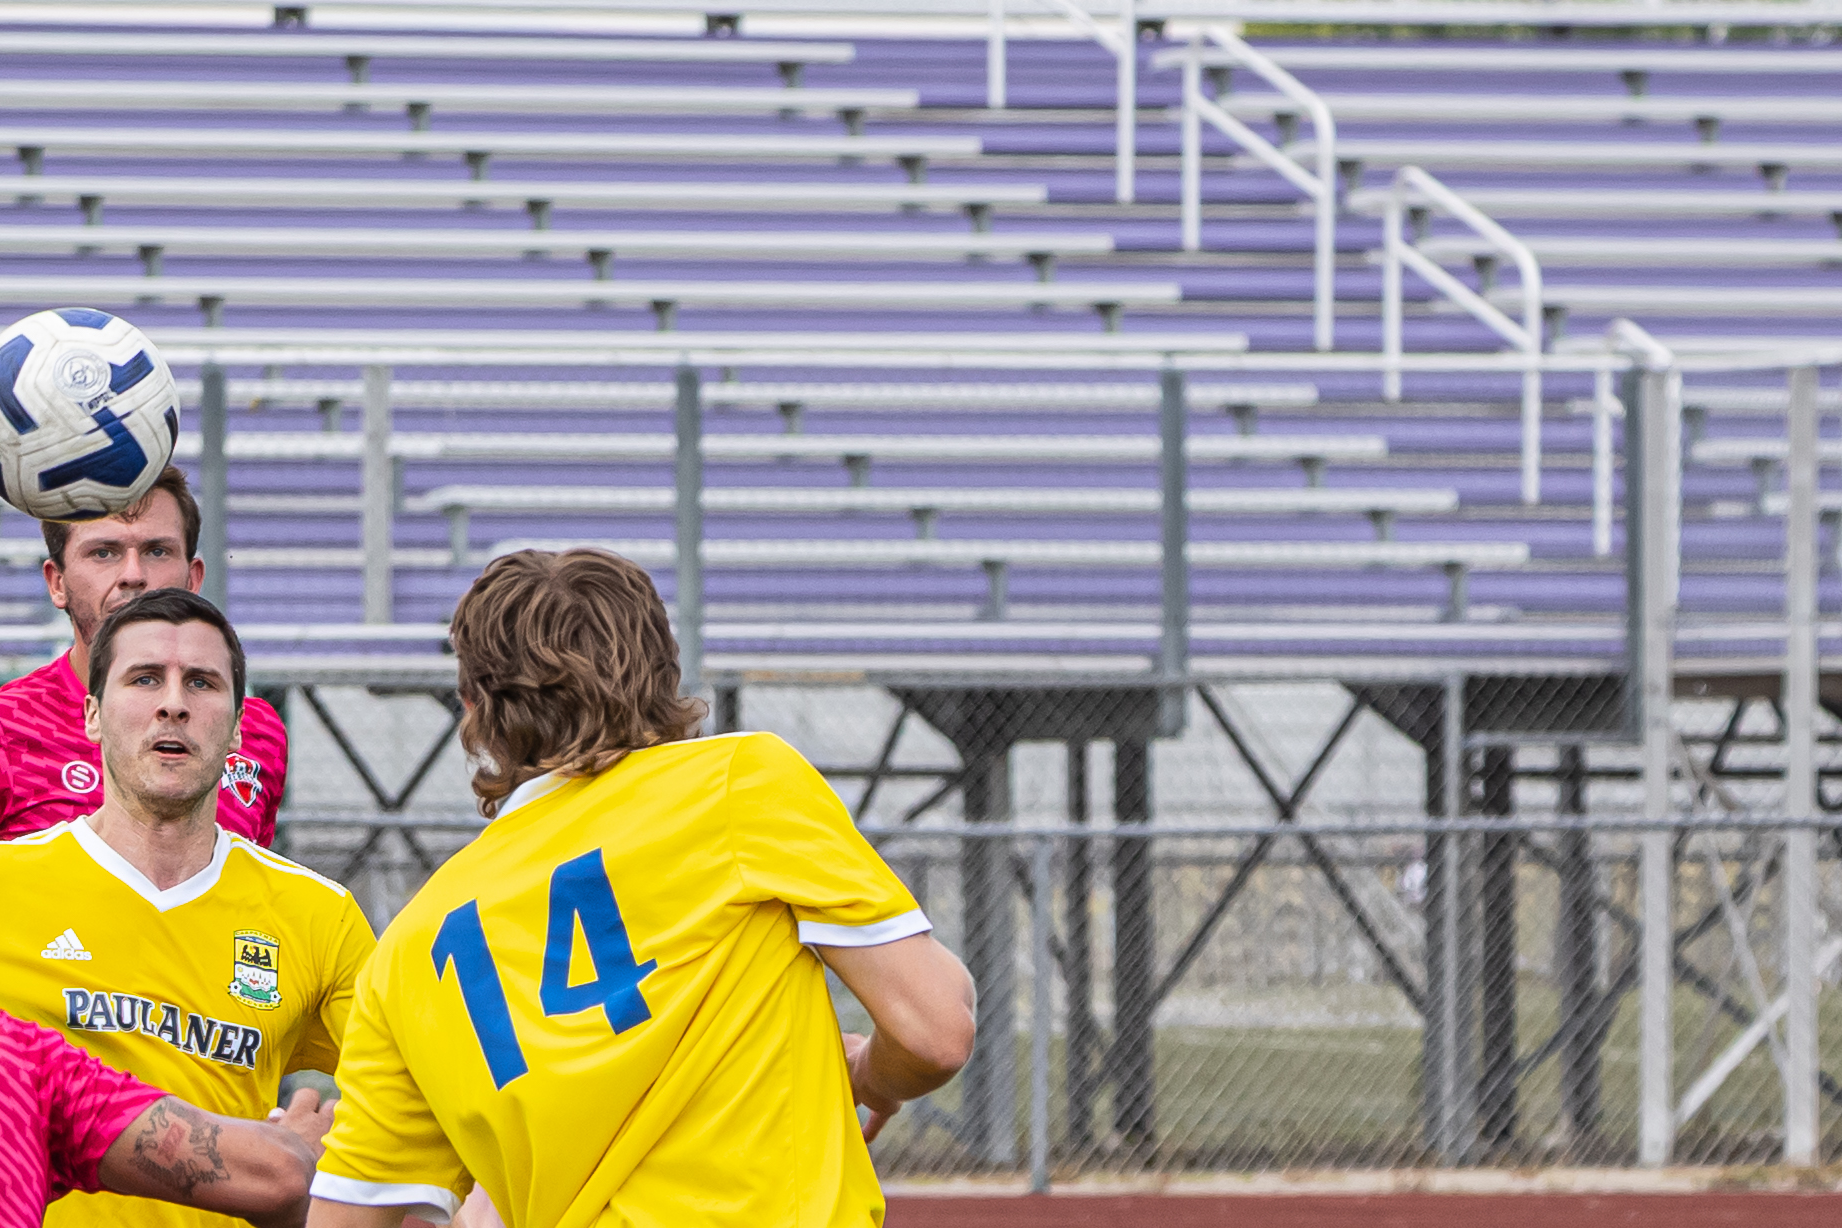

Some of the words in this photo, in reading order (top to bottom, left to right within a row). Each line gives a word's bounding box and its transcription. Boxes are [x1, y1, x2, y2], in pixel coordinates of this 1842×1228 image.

[40, 947, 93, 961] adidas
[431, 848, 657, 1091] 14
[62, 988, 262, 1070] PAULANER
